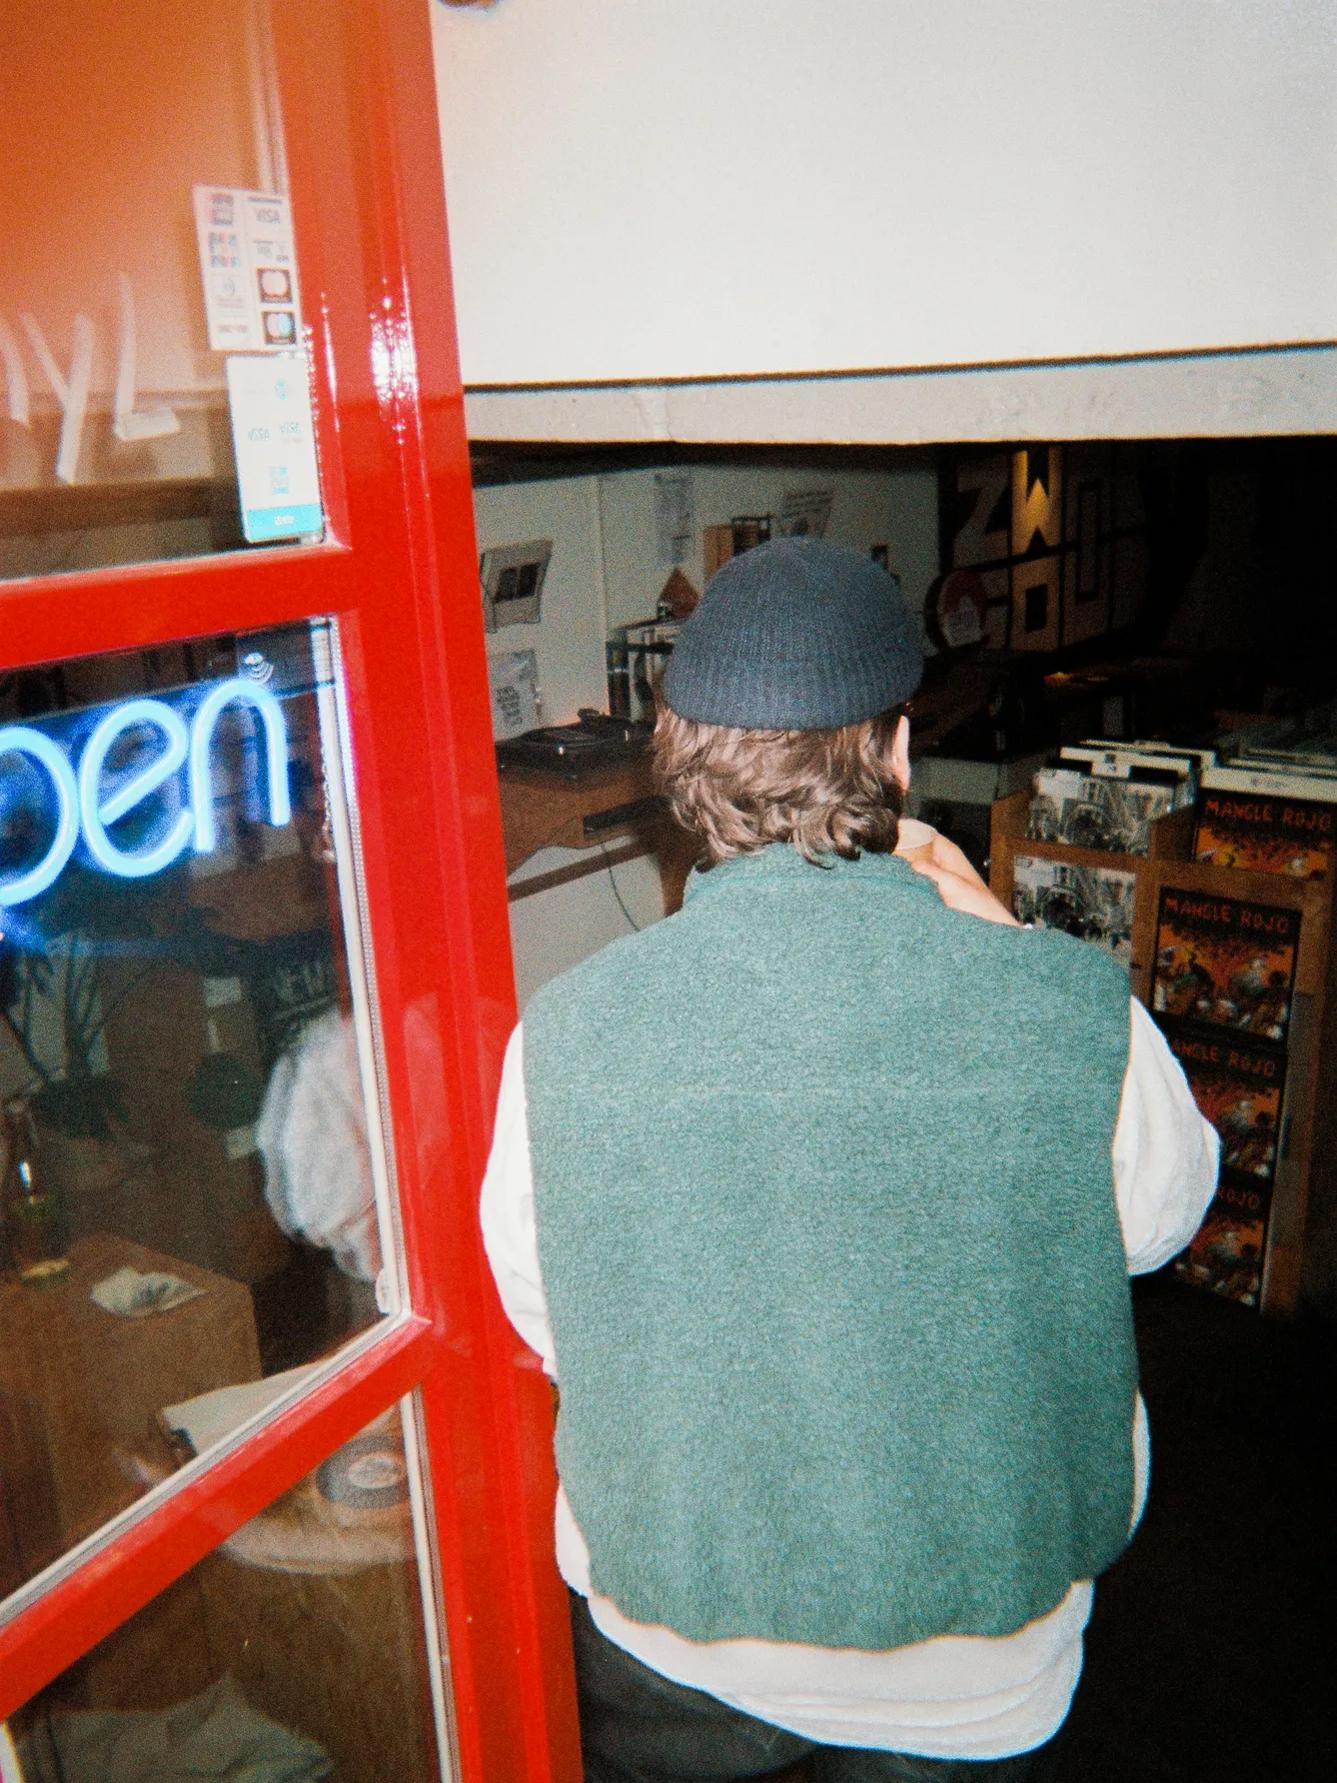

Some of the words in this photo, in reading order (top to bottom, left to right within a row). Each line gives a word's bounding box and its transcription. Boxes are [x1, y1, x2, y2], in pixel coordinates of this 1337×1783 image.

[1204, 799, 1273, 824] MANGLE
[1283, 808, 1332, 833] ROJO
[1164, 896, 1232, 923] MANGLE
[1239, 910, 1290, 934] ROJO
[1227, 1050, 1278, 1079] ROJO
